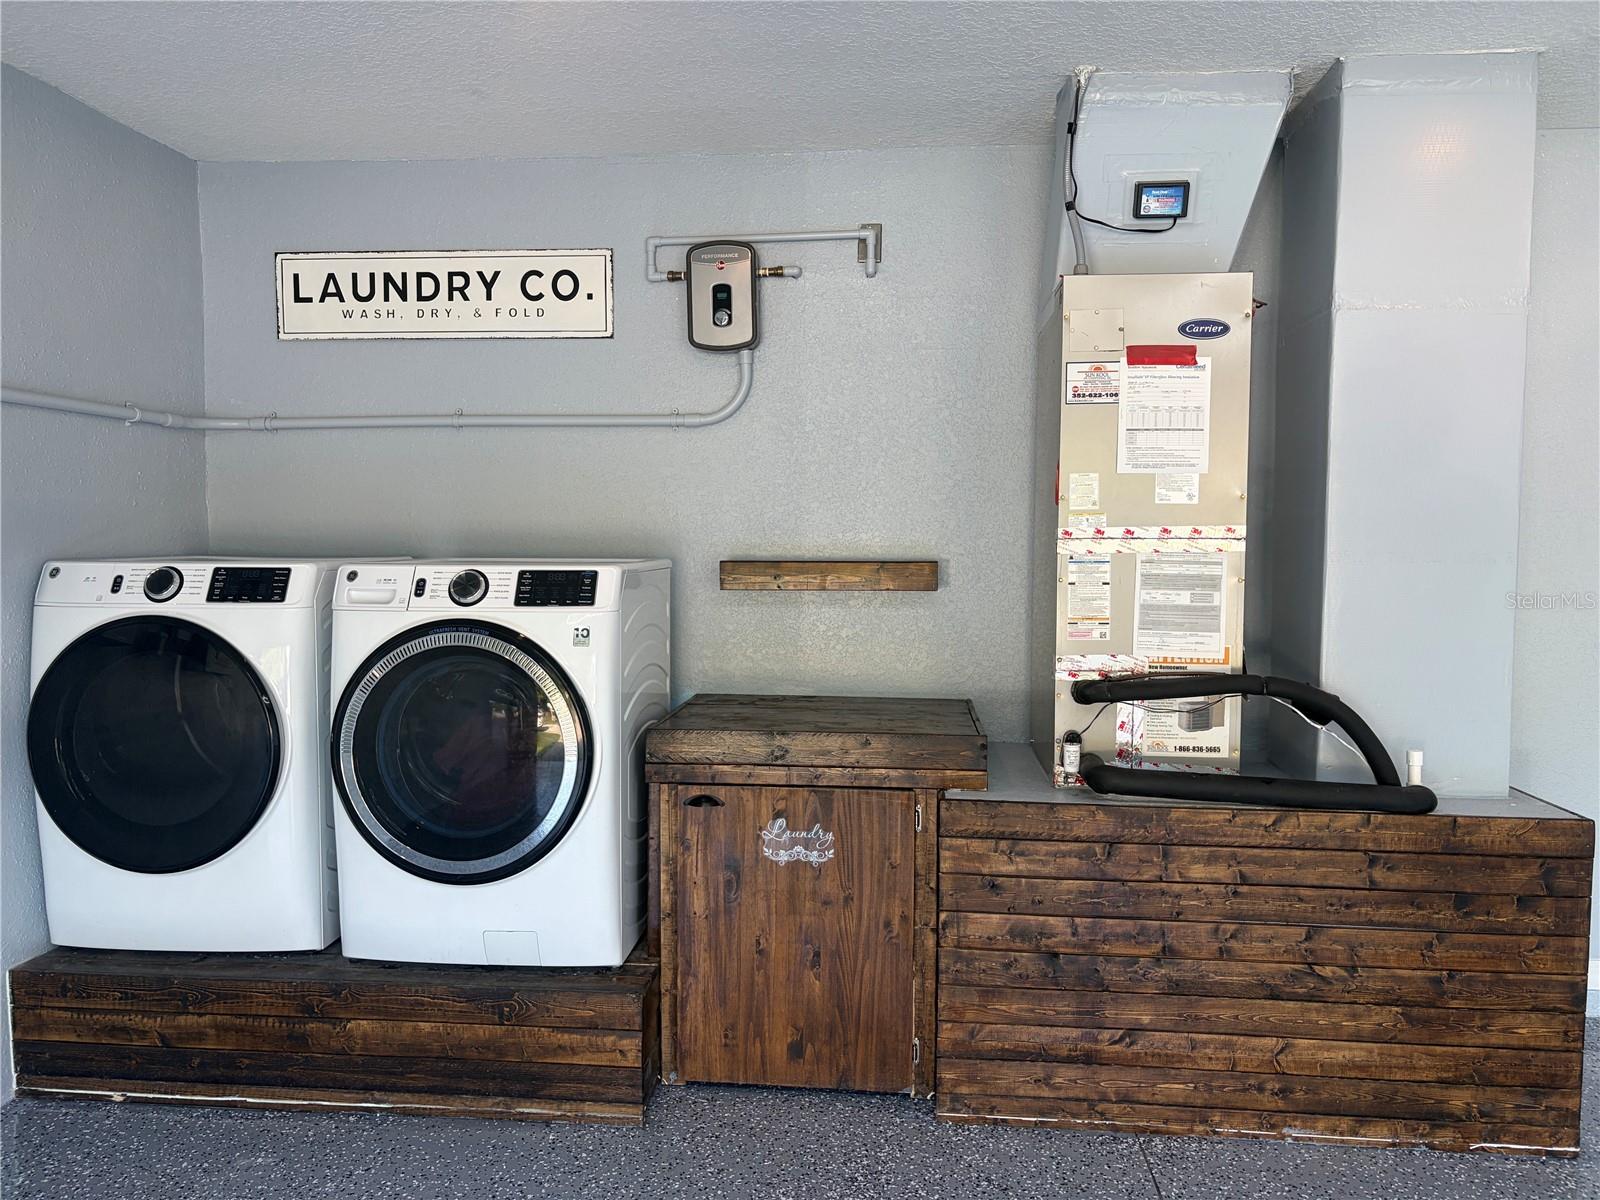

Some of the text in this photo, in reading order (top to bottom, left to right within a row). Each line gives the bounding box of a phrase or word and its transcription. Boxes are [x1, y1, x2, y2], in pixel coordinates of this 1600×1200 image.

[292, 269, 594, 303] LAUNDRY CO.
[341, 308, 545, 321] WASH, DRY, & FOLD
[1186, 324, 1224, 333] Carrier
[1093, 528, 1105, 537] 3M
[1123, 528, 1135, 537] 3M
[1160, 527, 1172, 536] 3M
[1190, 527, 1203, 536] 3M
[472, 627, 490, 635] SYSTEM
[762, 818, 835, 849] Laundry
